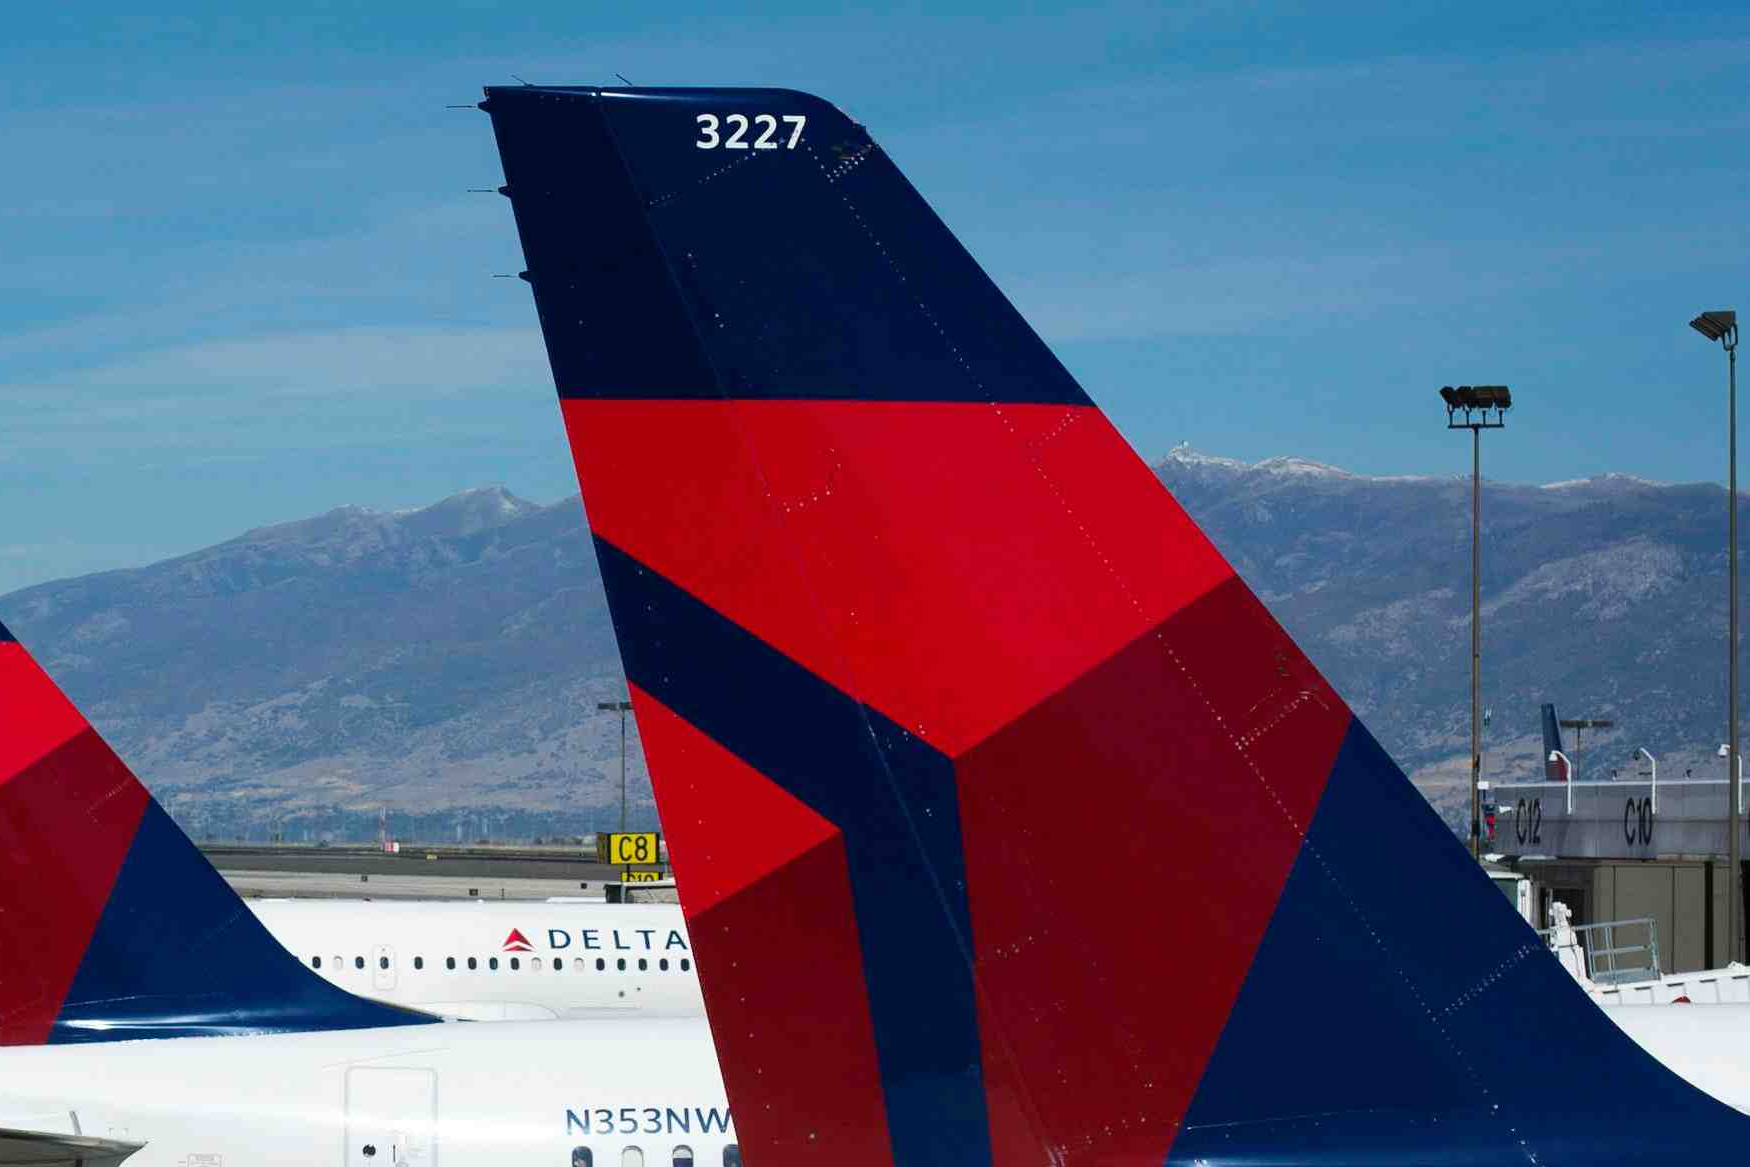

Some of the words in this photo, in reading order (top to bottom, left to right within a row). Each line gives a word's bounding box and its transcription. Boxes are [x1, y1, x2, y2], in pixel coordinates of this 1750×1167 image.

[695, 113, 807, 149] 3227
[1515, 797, 1542, 846] C12
[1623, 797, 1653, 846] C10
[617, 834, 649, 862] C8
[547, 928, 689, 951] DELTA
[565, 1106, 731, 1136] N353NW
